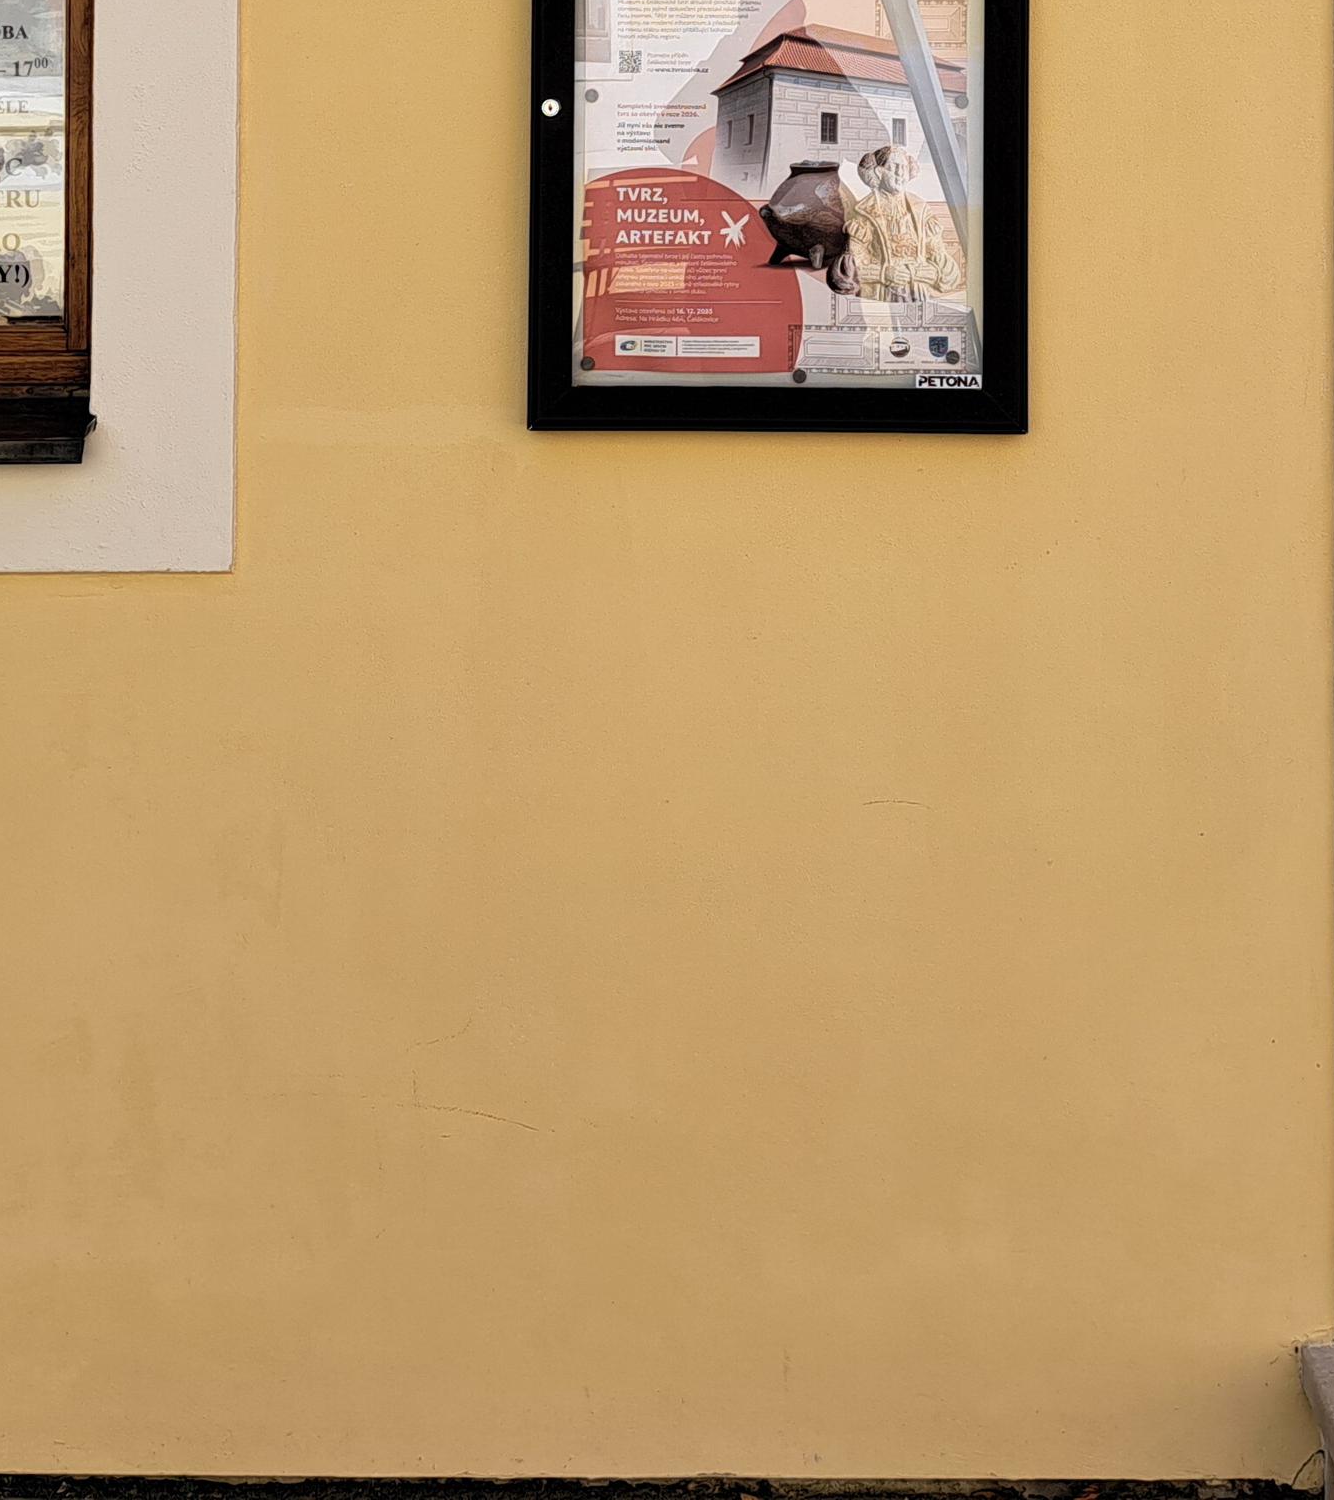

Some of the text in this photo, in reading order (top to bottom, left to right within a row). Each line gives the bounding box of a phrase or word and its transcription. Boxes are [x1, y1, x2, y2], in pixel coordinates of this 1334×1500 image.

[616, 187, 669, 205] TVRZ,
[616, 208, 706, 227] MUZEUM,
[615, 229, 712, 245] ARTEFAKT
[918, 375, 980, 388] PETONA
